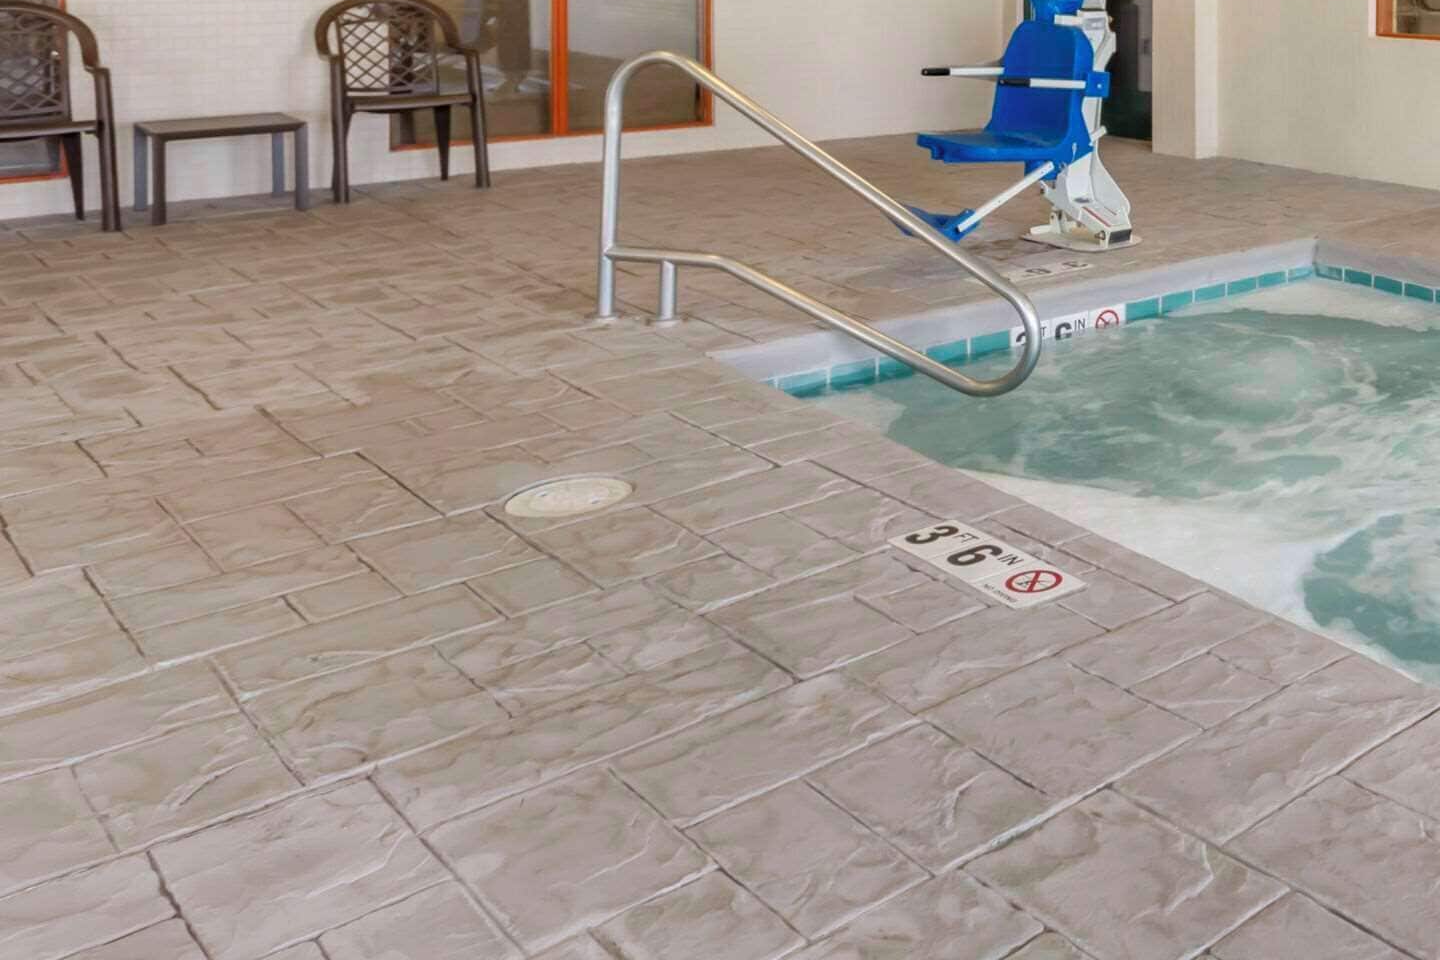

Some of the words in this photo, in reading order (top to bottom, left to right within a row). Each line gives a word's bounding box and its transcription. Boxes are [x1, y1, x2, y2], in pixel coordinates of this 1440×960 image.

[1074, 318, 1085, 330] IN
[905, 525, 960, 545] 3
[952, 531, 980, 544] FT
[946, 544, 1003, 567] 6
[997, 553, 1025, 567] IN
